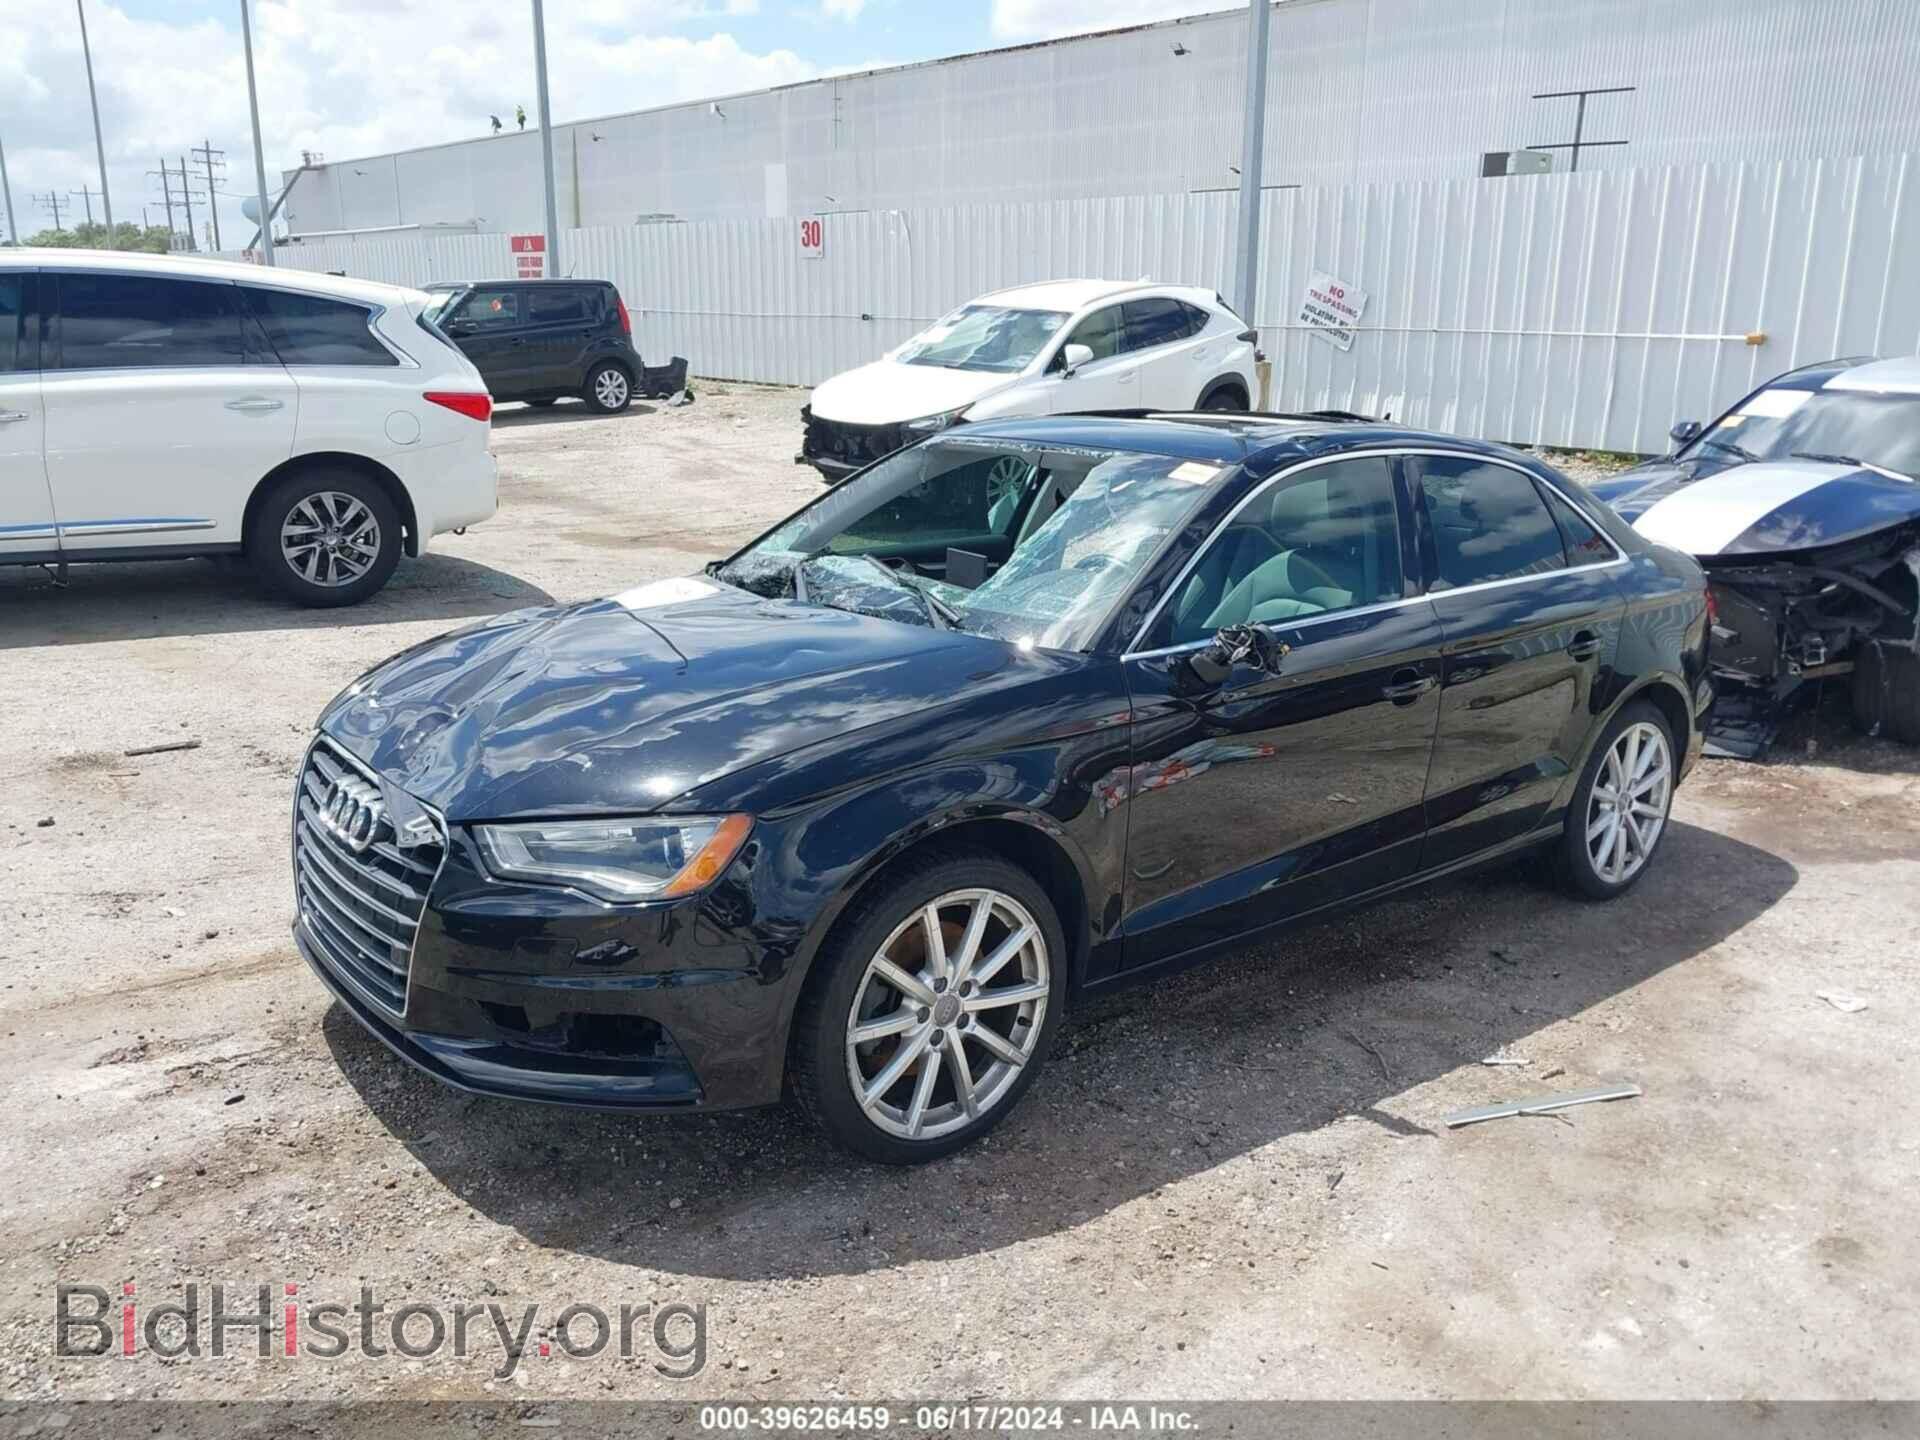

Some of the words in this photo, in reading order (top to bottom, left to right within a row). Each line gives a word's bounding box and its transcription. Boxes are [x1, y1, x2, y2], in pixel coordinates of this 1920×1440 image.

[801, 220, 821, 248] 30
[1310, 289, 1358, 319] TRESPASSING
[1329, 285, 1345, 299] NO
